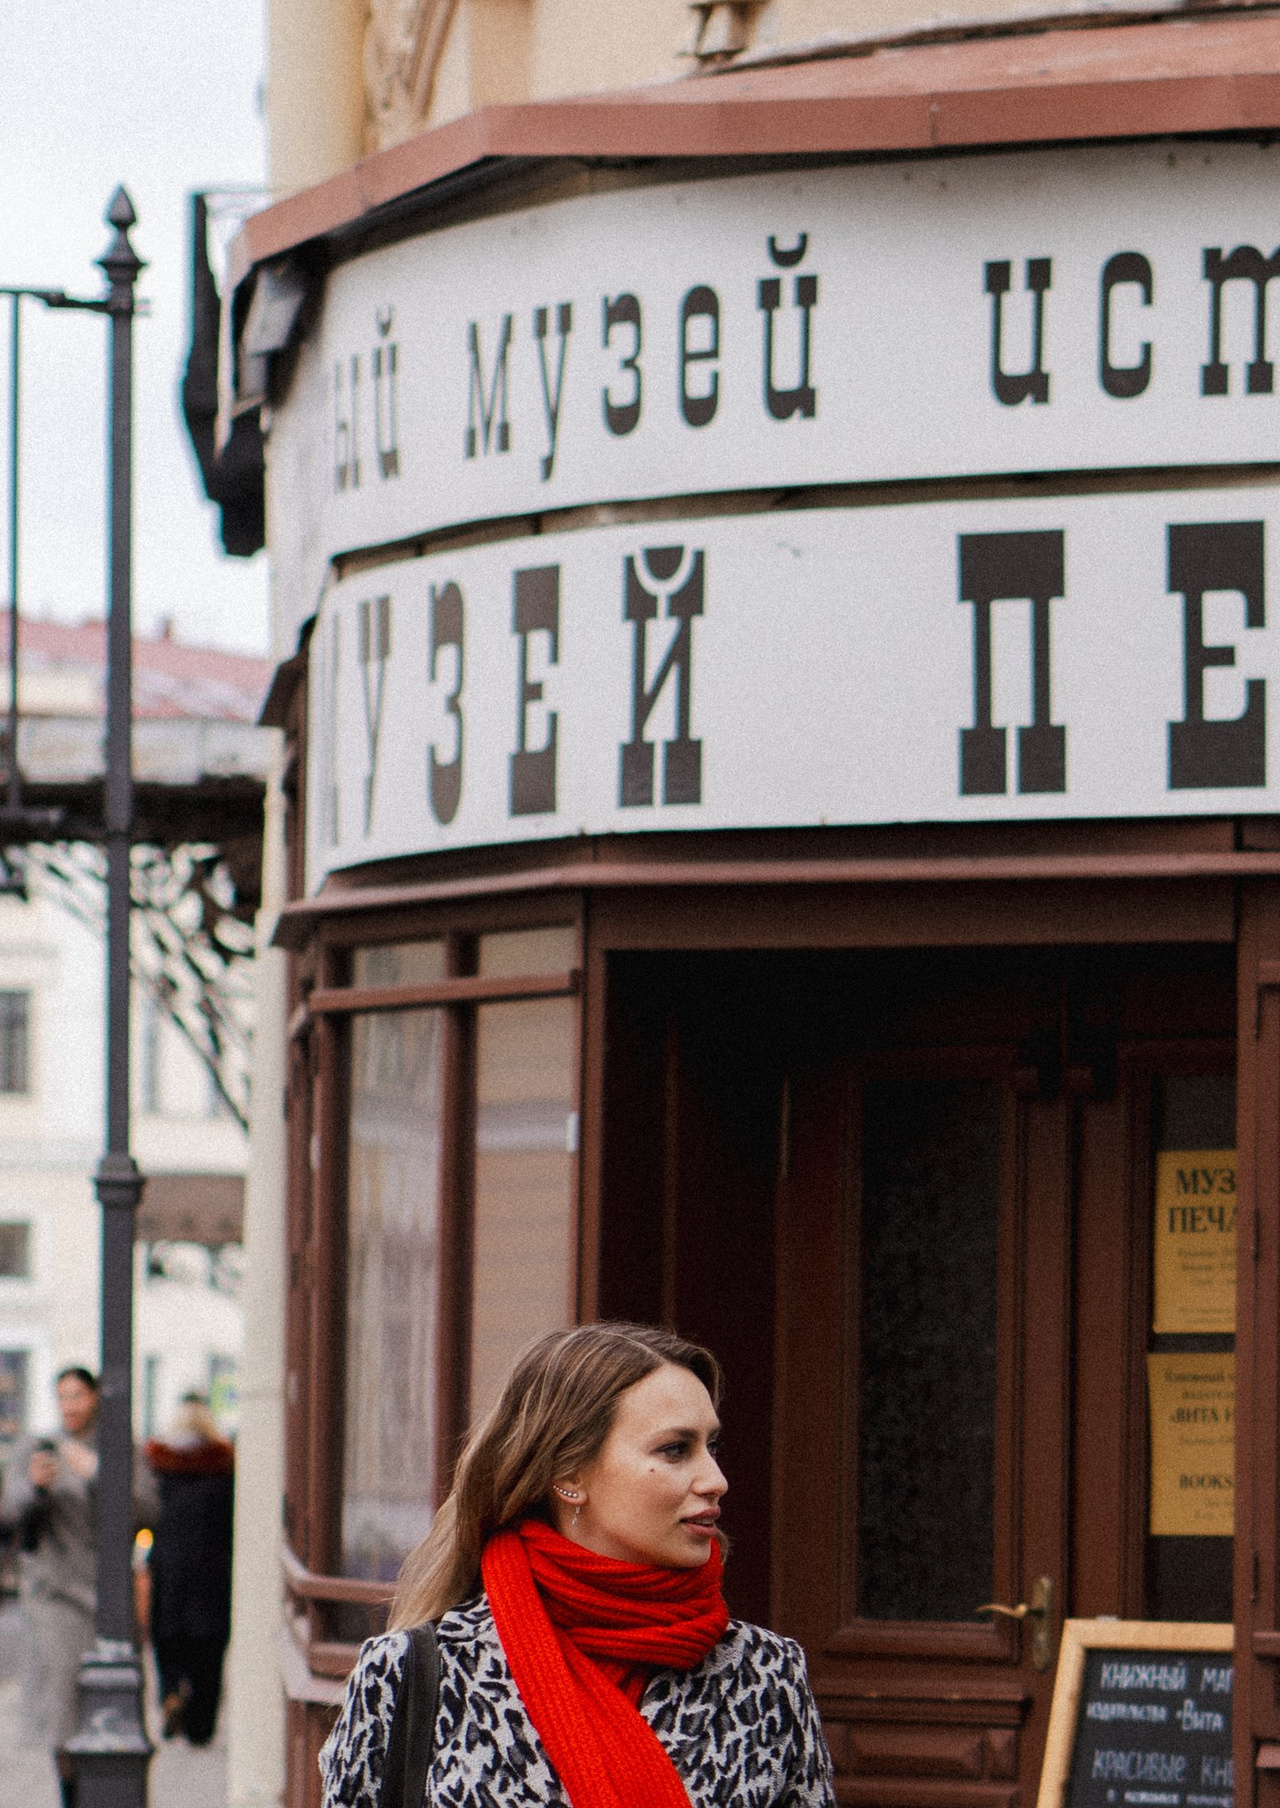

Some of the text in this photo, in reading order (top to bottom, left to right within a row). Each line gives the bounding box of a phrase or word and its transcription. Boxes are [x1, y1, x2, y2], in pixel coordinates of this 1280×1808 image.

[464, 232, 818, 483] музей
[1175, 1168, 1236, 1195] МУЗ
[1100, 1660, 1188, 1691] КНИЖНЫЙ
